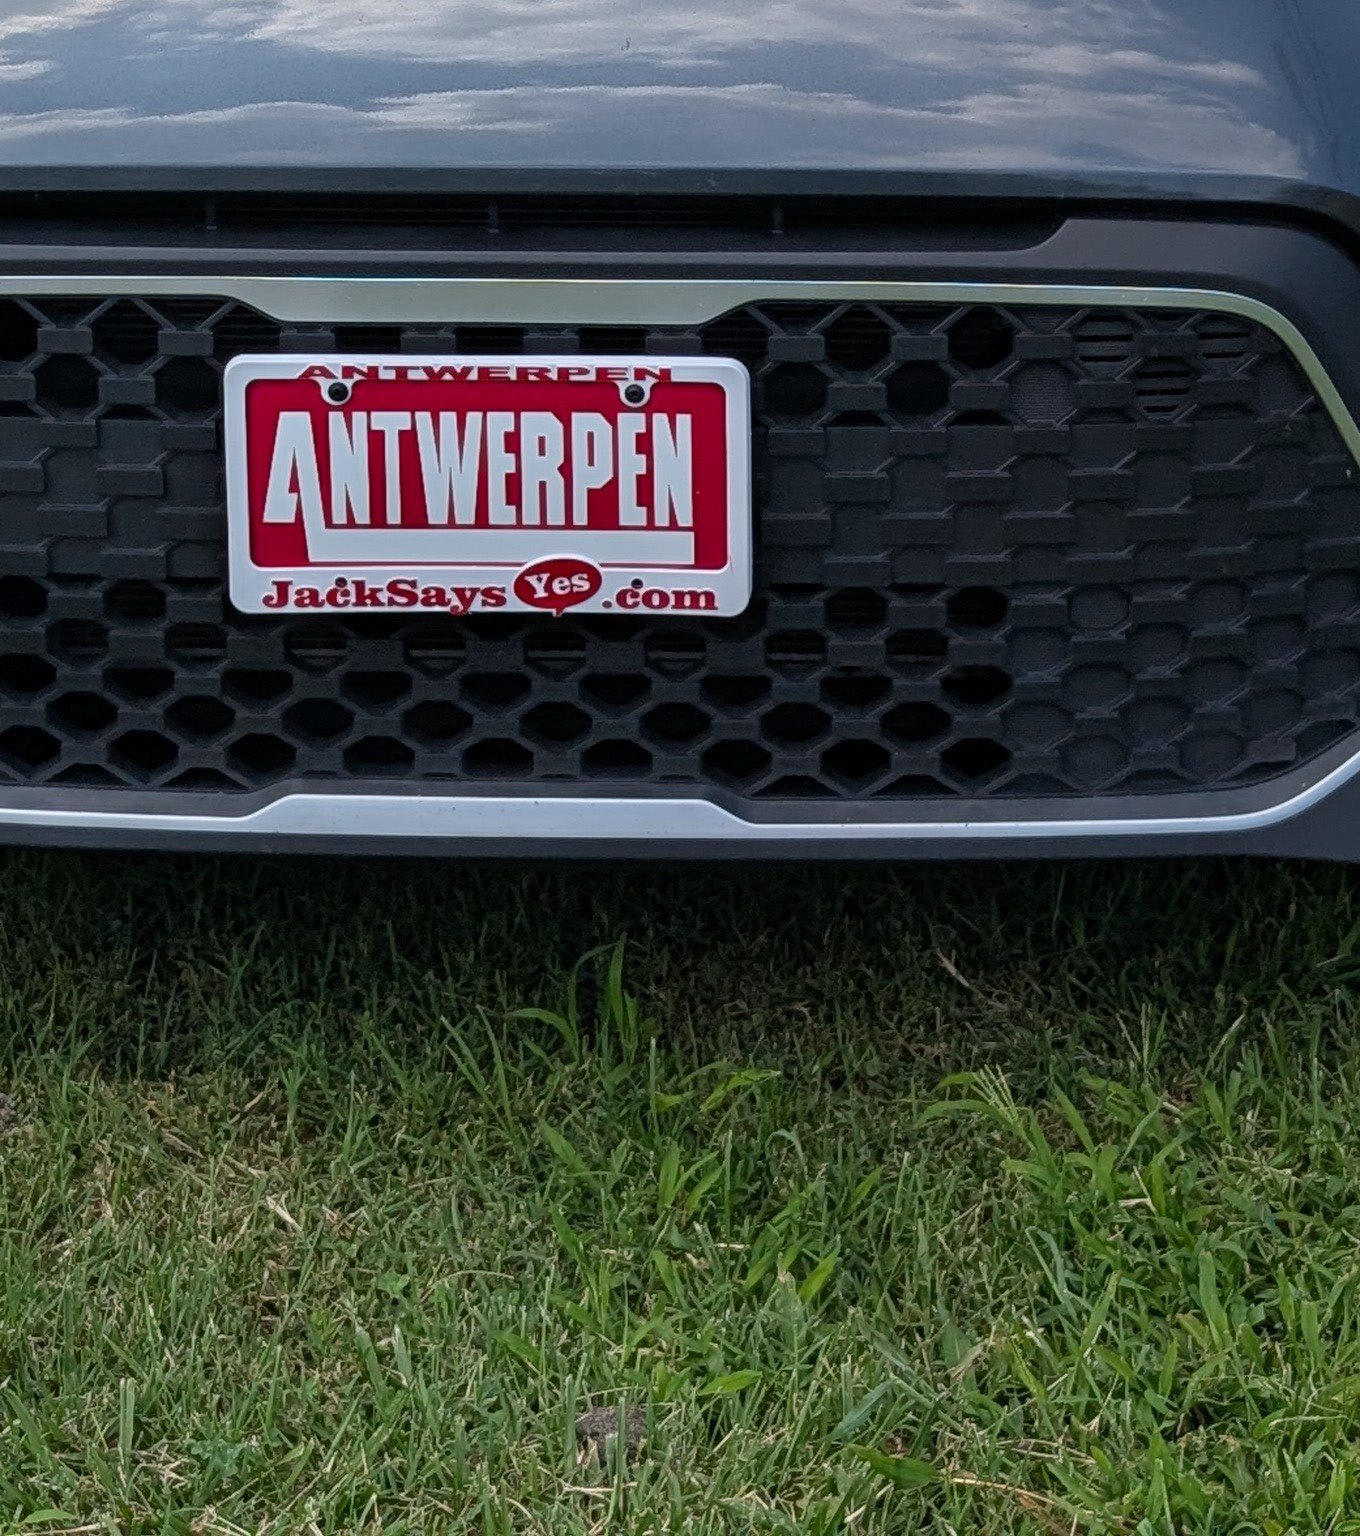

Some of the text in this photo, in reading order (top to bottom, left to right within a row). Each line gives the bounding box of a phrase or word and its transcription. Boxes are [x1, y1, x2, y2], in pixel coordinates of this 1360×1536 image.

[297, 364, 672, 382] ANTWERPEN
[263, 411, 693, 527] ANTWERPEN
[525, 572, 591, 599] Yes
